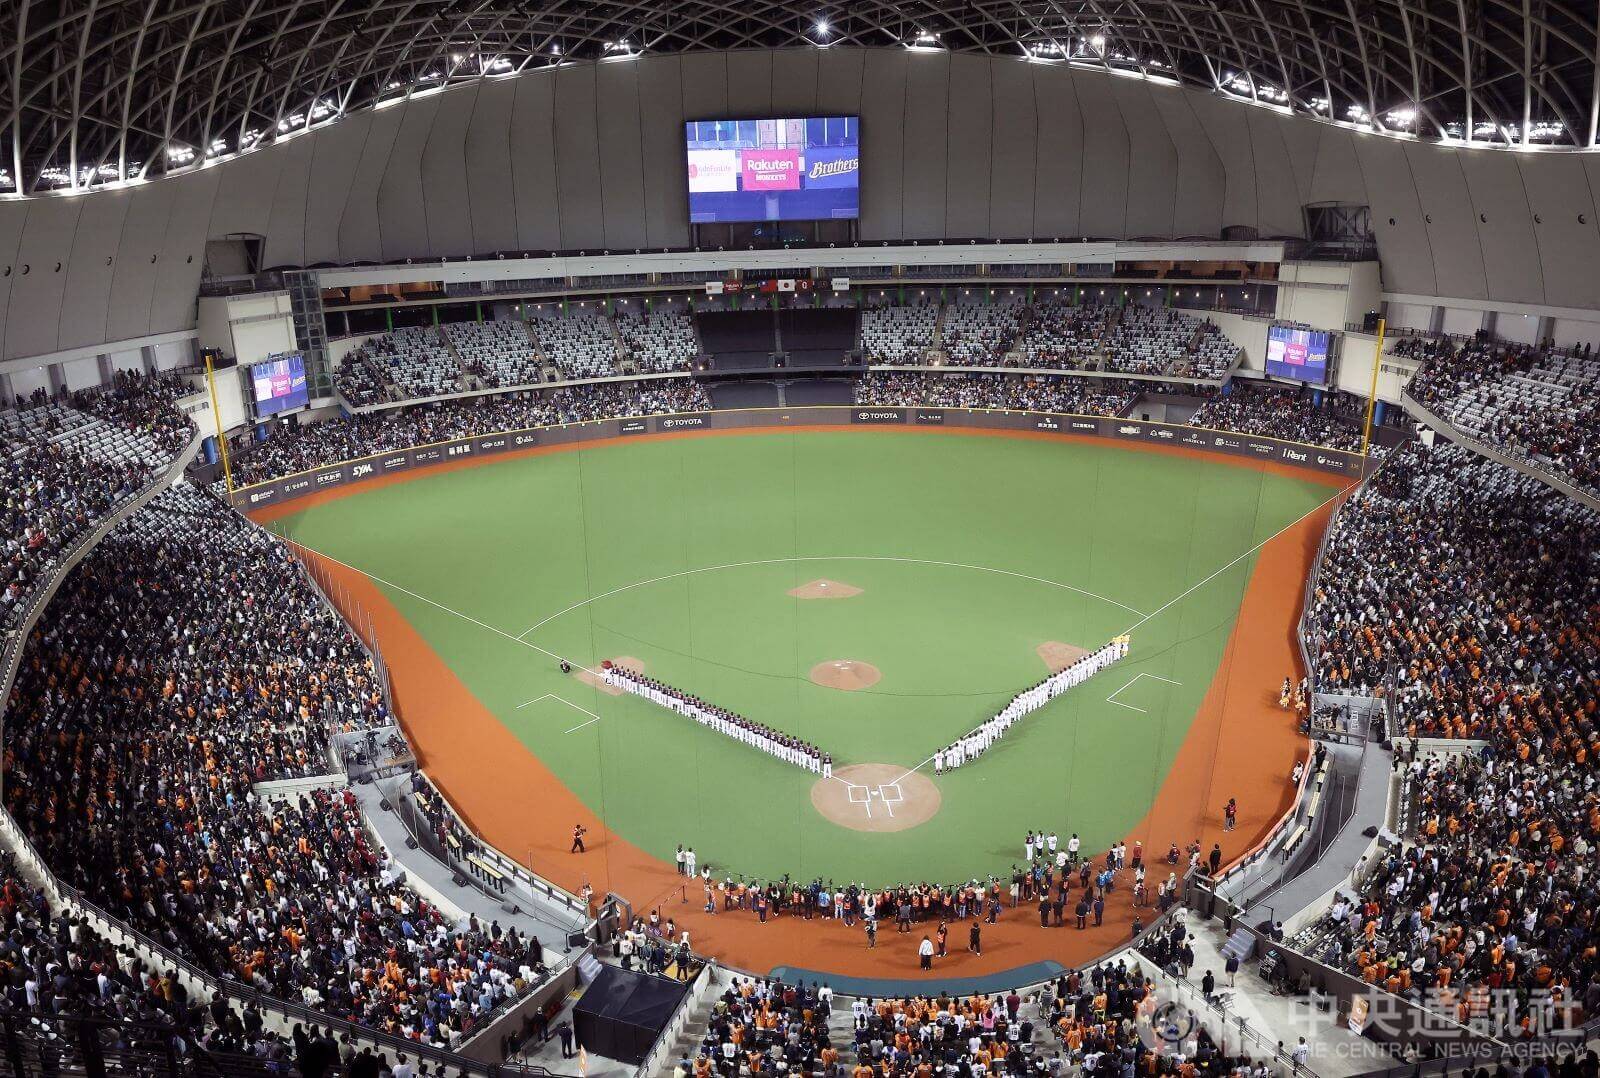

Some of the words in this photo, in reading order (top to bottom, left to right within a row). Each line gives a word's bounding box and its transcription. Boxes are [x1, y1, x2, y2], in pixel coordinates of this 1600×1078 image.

[747, 159, 794, 171] Rakuten
[809, 158, 859, 179] Brothers
[675, 418, 702, 426] TOYOTA
[353, 463, 373, 477] SYM
